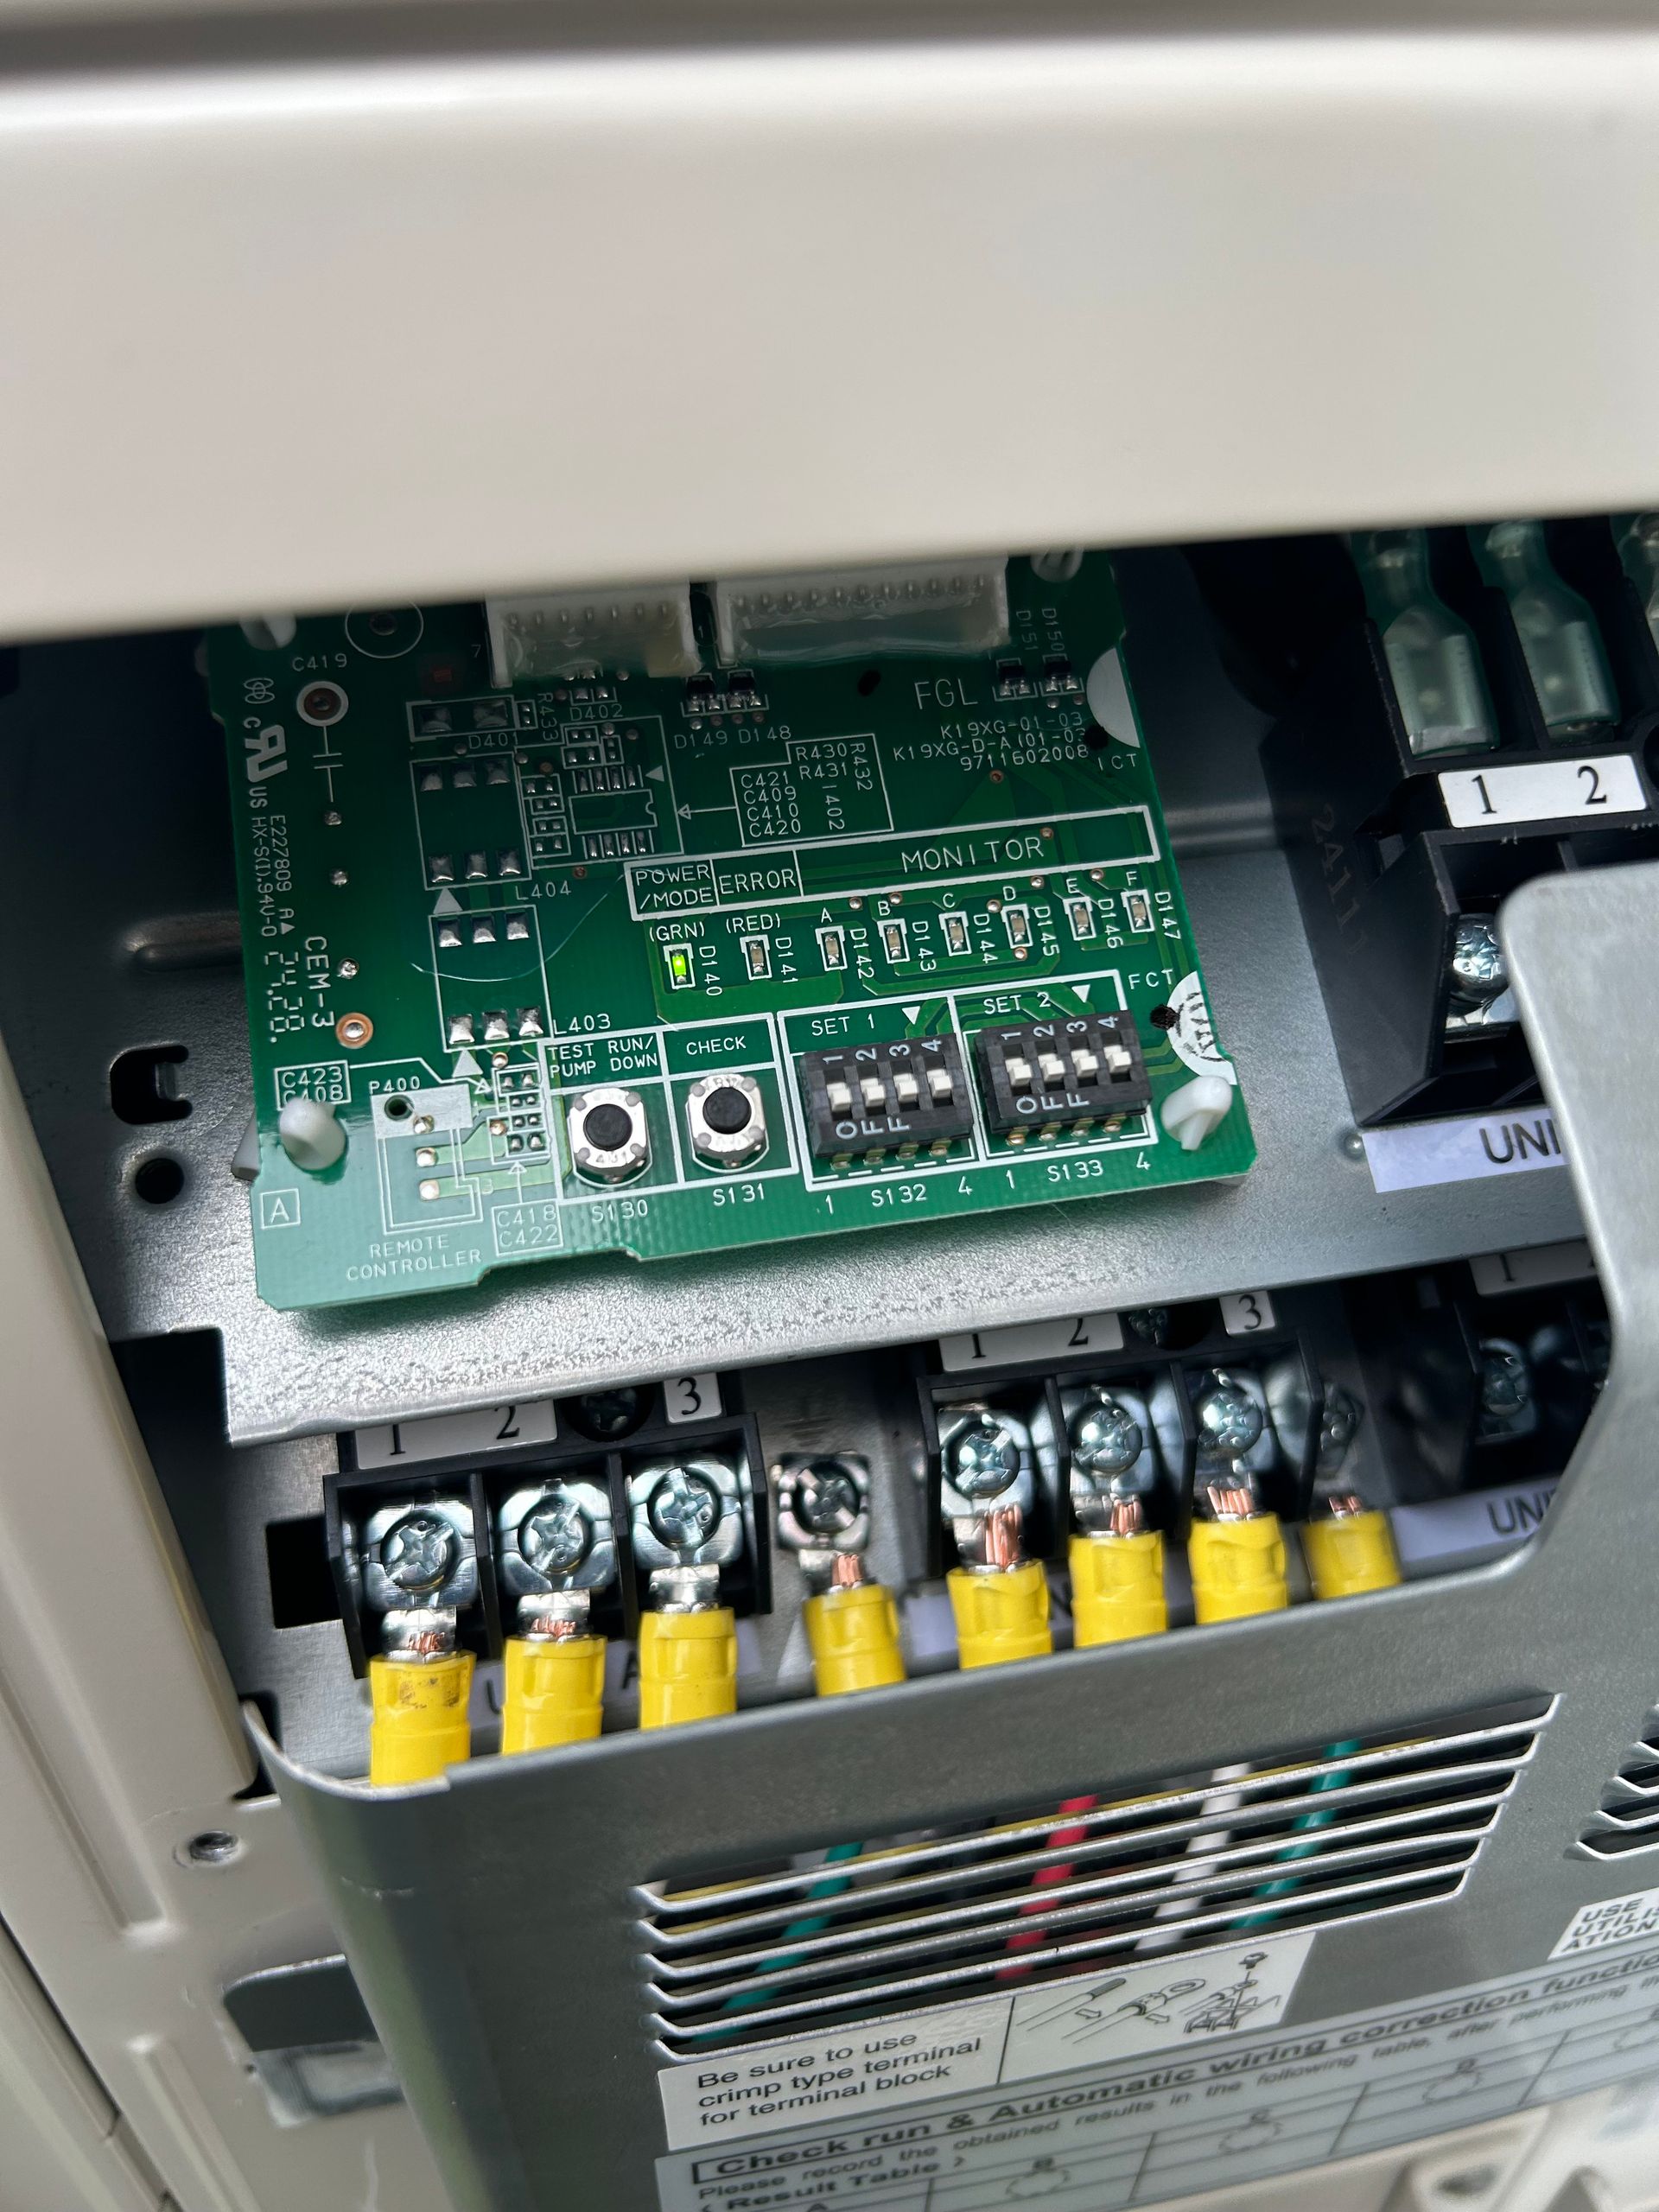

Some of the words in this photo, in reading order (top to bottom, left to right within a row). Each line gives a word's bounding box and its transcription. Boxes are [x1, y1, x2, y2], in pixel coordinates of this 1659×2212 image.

[1042, 608, 1065, 652] D150
[292, 653, 347, 671] C419
[914, 678, 978, 709] FGL
[537, 693, 557, 741] R433
[570, 704, 623, 721] D402
[468, 732, 518, 749] D401
[674, 730, 728, 748] D149
[739, 726, 791, 743] D148
[796, 742, 847, 761] R430
[799, 762, 847, 780] R431
[850, 742, 873, 791] R432
[741, 771, 789, 789] C421
[1471, 775, 1497, 815] 1
[1577, 766, 1606, 804] 2
[743, 786, 796, 804] C409
[747, 803, 798, 822] C410
[749, 819, 801, 837] C420
[270, 816, 291, 892] E227809
[901, 837, 1044, 873] MONITOR
[635, 864, 711, 886] POWER
[719, 868, 796, 895] ERROR
[1066, 879, 1079, 893] E
[1127, 871, 1137, 886] F
[515, 880, 571, 899] L404
[640, 887, 714, 909] /MODE
[943, 893, 955, 908] C
[1002, 887, 1016, 901] D
[821, 908, 832, 923] A
[878, 901, 890, 916] B
[1155, 892, 1180, 939] D147
[649, 921, 705, 942] (GRN)
[726, 913, 780, 933] (RED)
[1034, 906, 1059, 957] D145
[1097, 898, 1123, 949] D146
[912, 921, 937, 971] D143
[974, 913, 998, 964] D144
[775, 938, 798, 983] D141
[850, 928, 874, 980] D142
[305, 936, 334, 1027] CEM-3
[699, 945, 722, 995] D140
[1128, 969, 1173, 989] FCT
[983, 995, 1021, 1014] SET
[1038, 992, 1051, 1007] 2
[553, 1014, 610, 1034] L403
[811, 1016, 849, 1036] SET
[868, 1014, 874, 1029] 1
[1001, 1032, 1021, 1040] 1
[1033, 1024, 1054, 1037] 2
[1066, 1020, 1087, 1033] 3
[1098, 1016, 1119, 1028] 4
[549, 1043, 594, 1060] TEST
[608, 1036, 653, 1053] RUN/
[686, 1036, 747, 1055] CHECK
[823, 1055, 843, 1064] 1
[855, 1048, 877, 1061] 2
[889, 1044, 911, 1056] 3
[921, 1039, 942, 1052] 4
[283, 1066, 342, 1088] C423
[550, 1061, 596, 1078] PUMP
[611, 1053, 658, 1071] DOWN
[369, 1076, 420, 1094] P400
[1479, 1119, 1560, 1164] UNI
[1007, 1171, 1015, 1189] 1
[1048, 1160, 1103, 1182] S133
[1136, 1152, 1150, 1170] 4
[713, 1184, 764, 1206] S131
[825, 1194, 834, 1214] 1
[871, 1184, 927, 1205] S132
[958, 1176, 972, 1194] 4
[271, 1199, 289, 1222] A
[497, 1207, 556, 1228] C418
[592, 1199, 648, 1222] S130
[370, 1235, 449, 1257] REMOTE
[499, 1226, 558, 1247] C422
[346, 1249, 481, 1281] CONTROLLER
[1240, 1296, 1262, 1330] 3
[494, 1406, 520, 1440] 2
[677, 1377, 702, 1416] 3
[1581, 1897, 1645, 1923] USE
[697, 2072, 738, 2088] Be
[749, 2055, 815, 2078] sure
[825, 2047, 853, 2062] to
[864, 2033, 917, 2054] use
[698, 2082, 781, 2107] crimp
[791, 2067, 854, 2090] type
[864, 2037, 981, 2073] terminal
[717, 2139, 849, 2174] Check
[864, 2123, 931, 2147] run
[989, 2067, 1195, 2121] Automatic
[1211, 2039, 1327, 2074] wiring
[1340, 1989, 1529, 2044] correction
[701, 2108, 740, 2126] for
[749, 2081, 865, 2117] terminal
[876, 2064, 951, 2091] block
[698, 2175, 786, 2199] Please
[802, 2154, 883, 2179] record
[899, 2145, 938, 2160] the
[953, 2118, 1059, 2151] obtained
[1074, 2100, 1154, 2126] results
[1170, 2092, 1191, 2106] in
[1206, 2080, 1243, 2097] the
[1257, 2054, 1358, 2086] following
[728, 2182, 836, 2209] Result
[848, 2162, 941, 2186] Table
